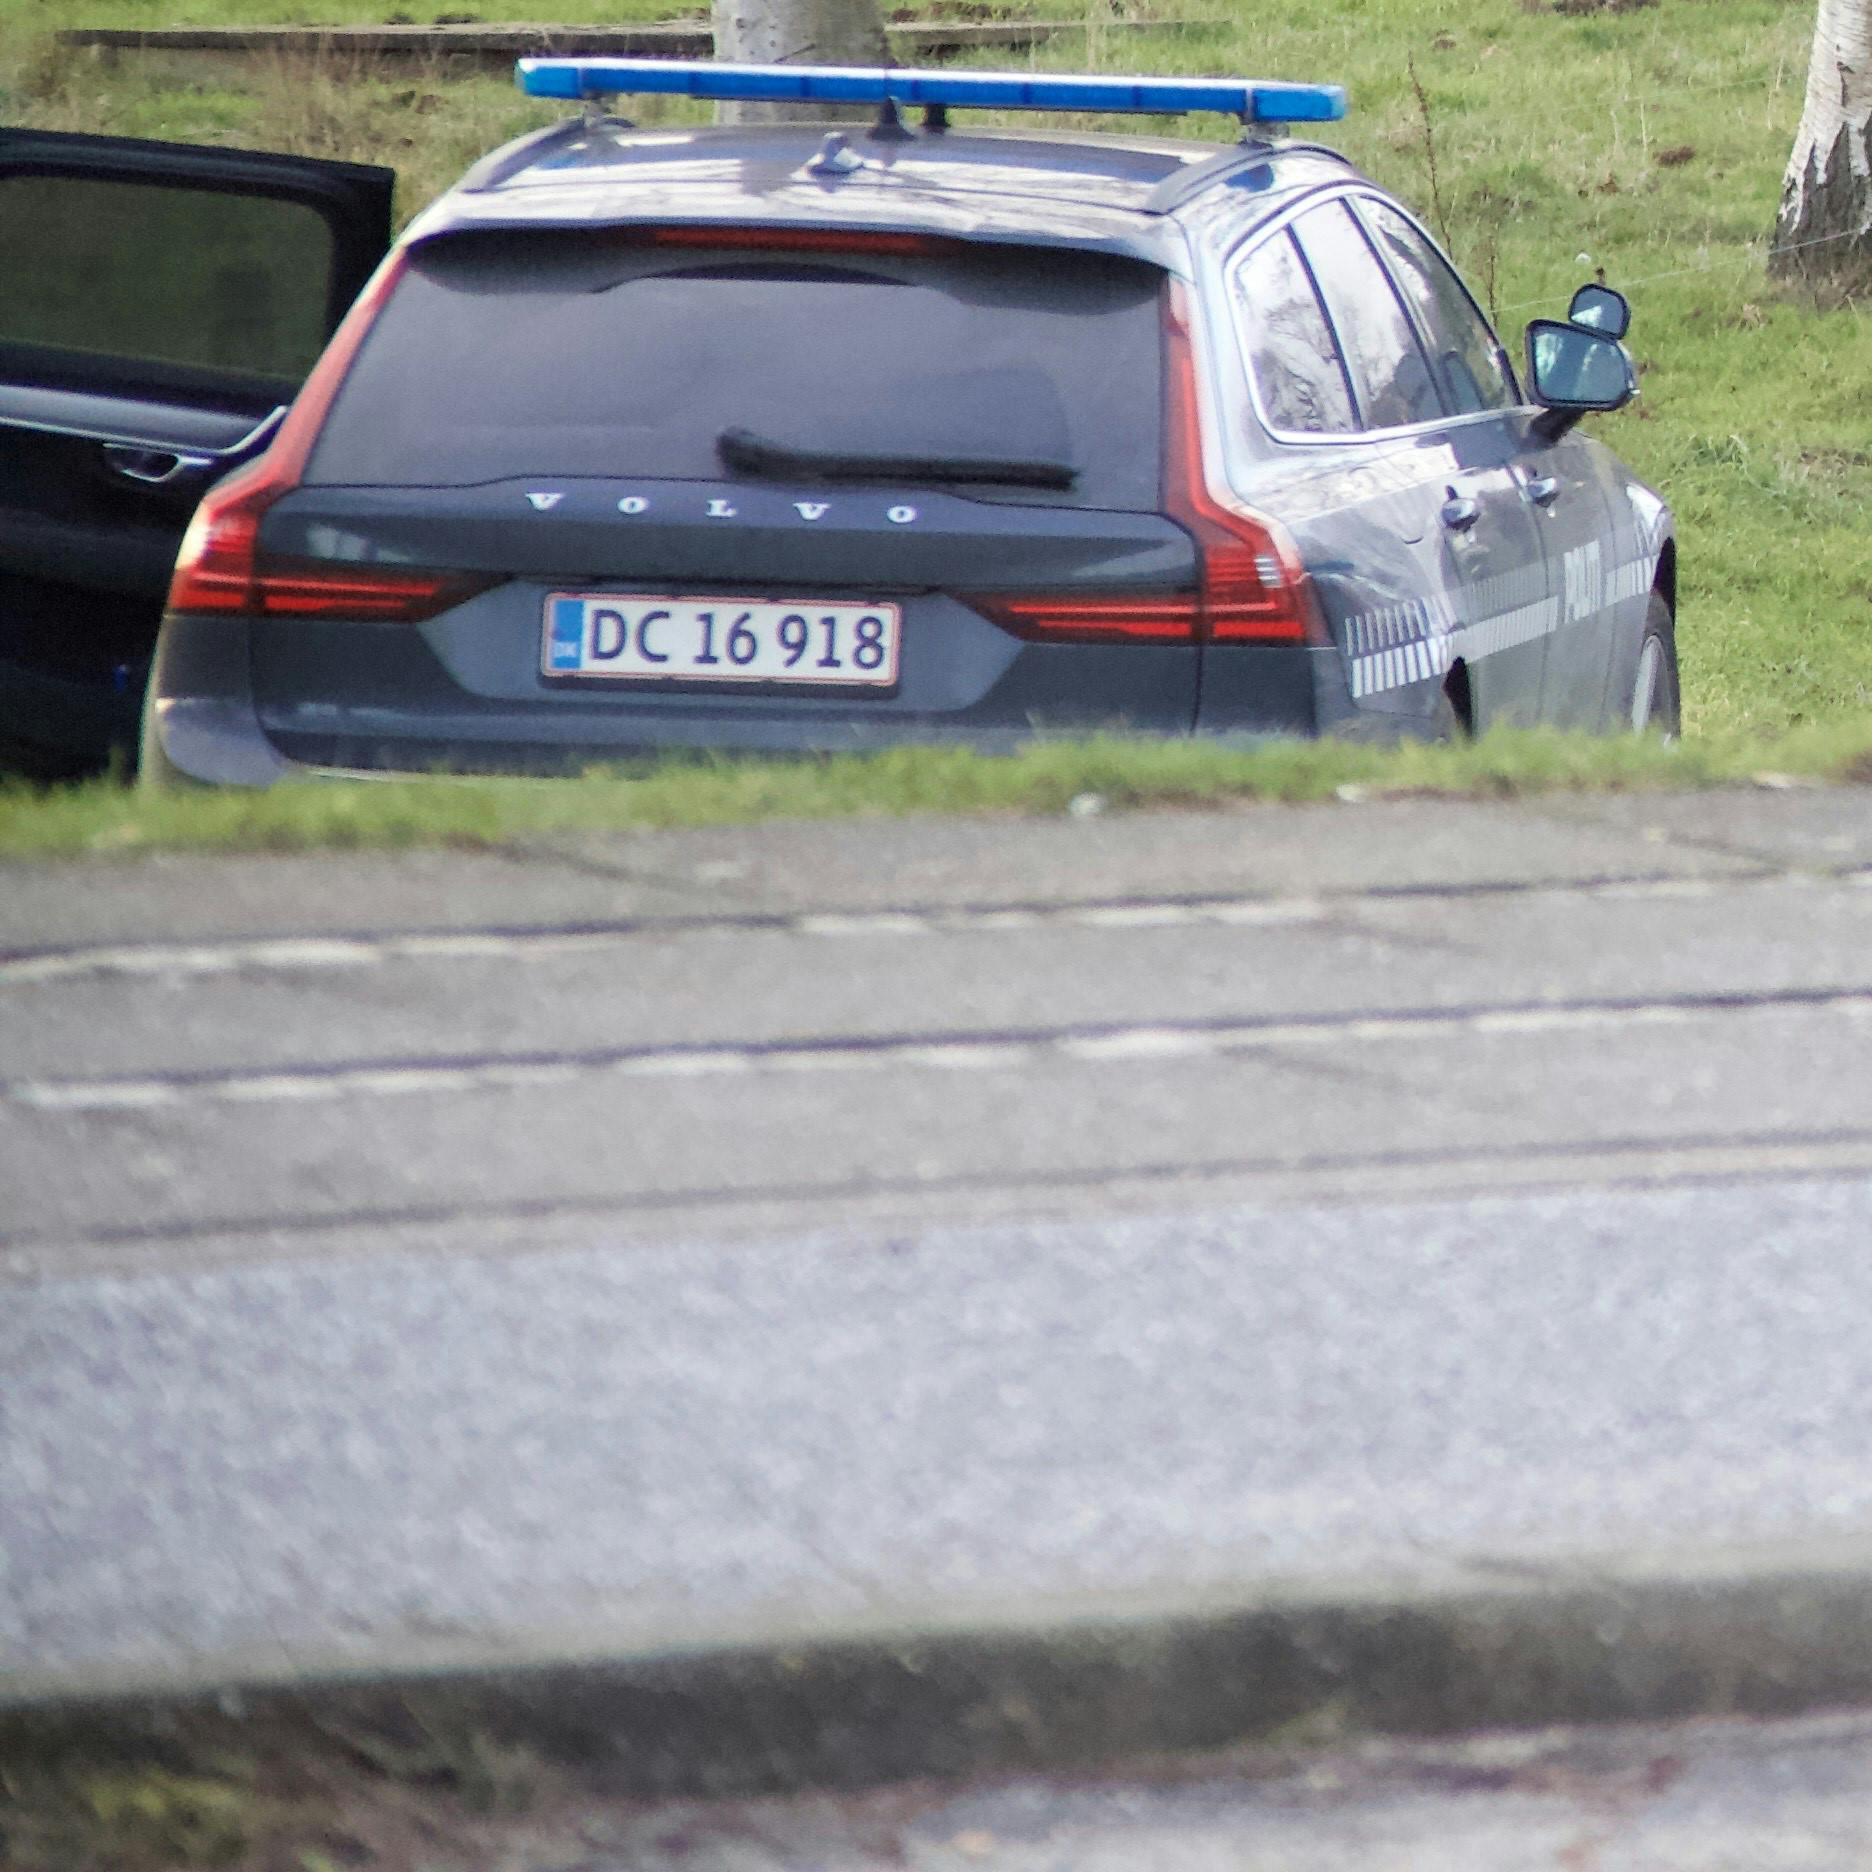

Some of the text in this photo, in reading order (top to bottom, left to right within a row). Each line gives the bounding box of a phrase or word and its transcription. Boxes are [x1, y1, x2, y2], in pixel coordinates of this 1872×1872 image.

[525, 492, 918, 524] VOLVO
[590, 609, 671, 662] DC
[693, 611, 758, 666] 16
[776, 613, 886, 669] 918
